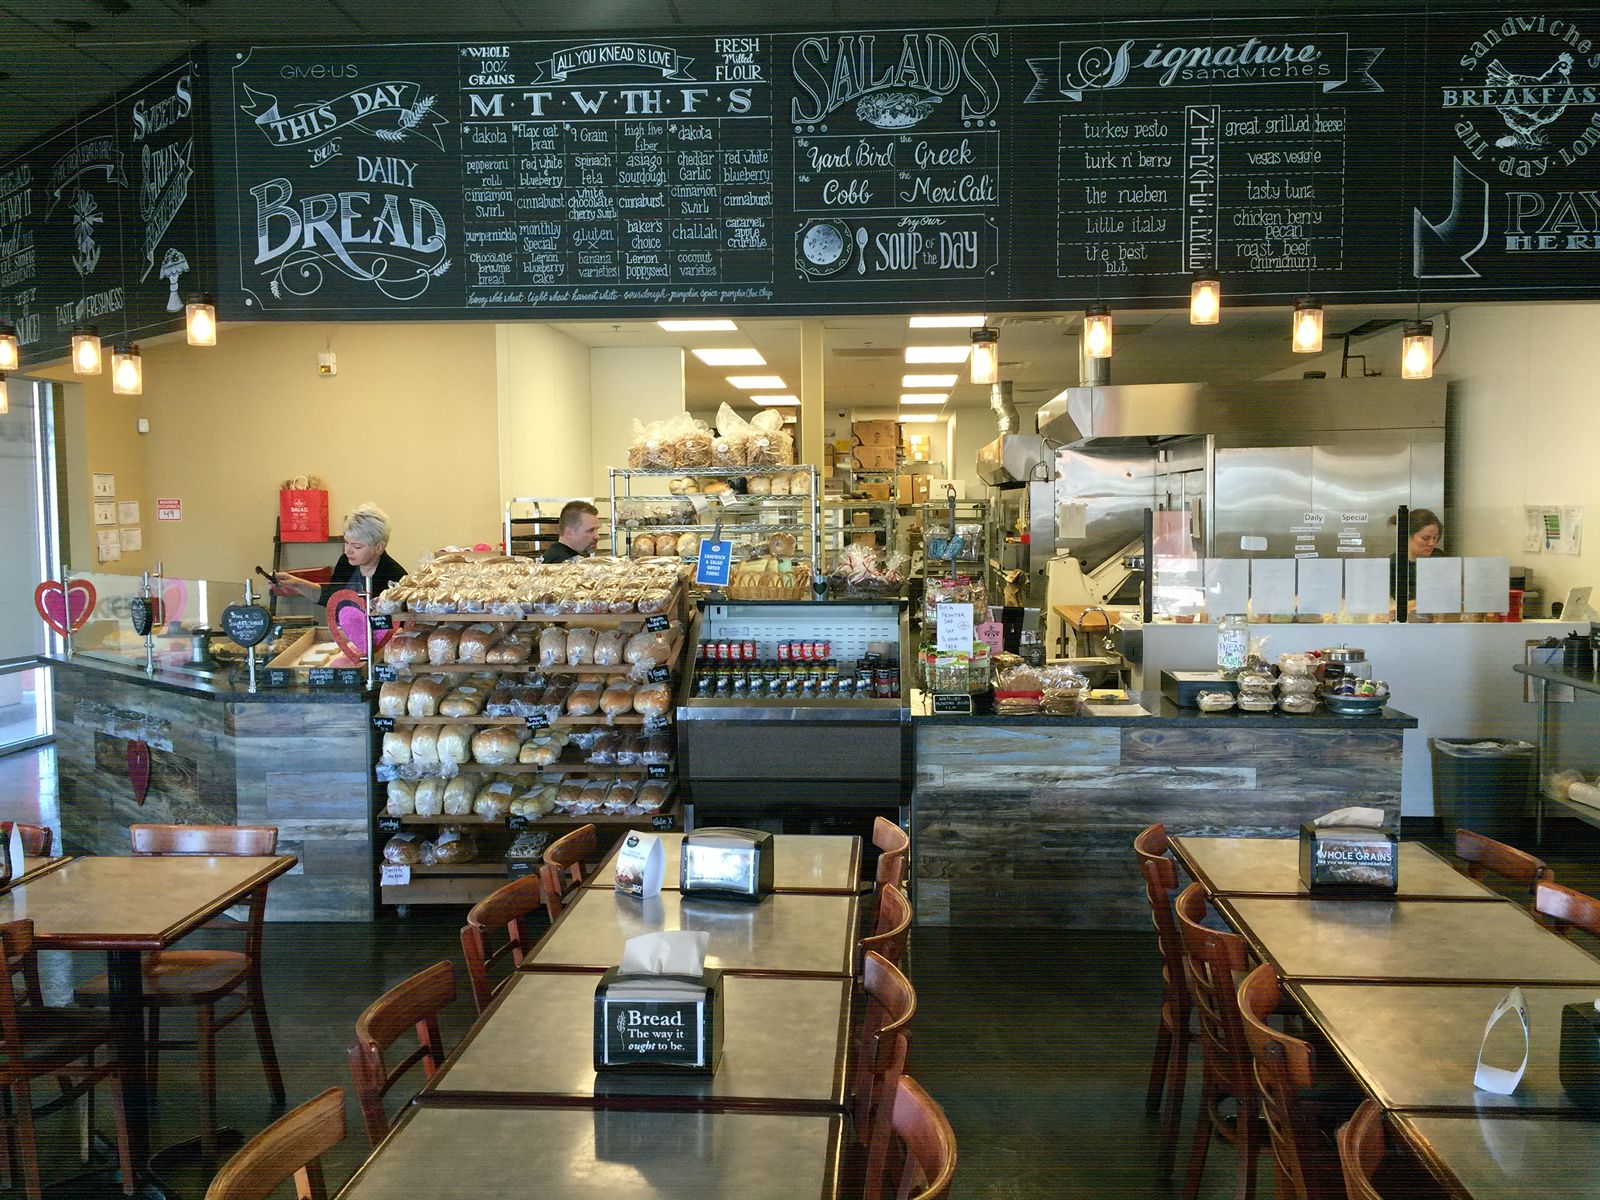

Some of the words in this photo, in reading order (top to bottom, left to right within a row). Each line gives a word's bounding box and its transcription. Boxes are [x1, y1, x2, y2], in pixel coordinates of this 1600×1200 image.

[467, 47, 510, 57] WHOLE
[715, 38, 760, 53] FRESH
[557, 53, 575, 72] ALL
[575, 49, 596, 65] YOU
[599, 46, 634, 62] KNEAD
[637, 48, 646, 63] IS
[649, 50, 671, 67] LOVE
[722, 53, 754, 64] Milled
[1066, 37, 1323, 90] Signature
[481, 60, 507, 74] 100%
[715, 65, 764, 81] FLOUR
[469, 75, 515, 85] GRAINS
[791, 32, 1000, 124] SALADS
[469, 94, 504, 117] M
[523, 92, 552, 116] T
[570, 91, 608, 114] W
[620, 90, 663, 114] TH
[680, 89, 709, 112] F
[727, 88, 753, 113] S
[271, 106, 336, 142] THIS
[351, 85, 408, 115] DAY
[517, 124, 540, 138] flax
[542, 124, 559, 138] oat
[624, 122, 645, 141] high
[647, 122, 664, 136] five
[678, 125, 713, 141] dakota
[1084, 121, 1129, 140] turkey
[1135, 119, 1168, 138] pesto
[1225, 117, 1261, 137] great
[1265, 114, 1311, 133] grilled
[472, 126, 507, 143] dakota
[580, 127, 608, 142] Grain
[530, 138, 556, 151] bran
[678, 151, 714, 166] cheddar
[724, 152, 741, 165] red
[743, 150, 768, 165] white
[807, 146, 852, 173] Yard
[856, 140, 895, 168] Bird
[914, 138, 976, 170] Greek
[1085, 151, 1117, 169] turk
[1138, 151, 1172, 168] berry
[1247, 151, 1282, 165] vegas
[466, 159, 509, 175] pepperoni
[520, 156, 538, 170] red
[540, 155, 563, 169] white
[575, 155, 612, 169] spinach
[626, 154, 662, 171] asiago
[1499, 155, 1549, 178] day
[357, 156, 418, 187] DAILY
[582, 169, 603, 185] feta
[723, 167, 770, 184] blueberry
[520, 173, 563, 188] blueberry
[464, 189, 513, 202] cinnamon
[576, 188, 604, 199] white
[671, 186, 717, 197] cinnamon
[823, 179, 874, 205] Cobb
[1086, 186, 1107, 204] the
[1246, 180, 1280, 200] tasty
[517, 193, 566, 209] cinnaburst
[567, 196, 614, 208] chocolate
[619, 193, 665, 208] cinnaburst
[723, 192, 772, 207] cinnaburst
[568, 209, 596, 221] cherry
[1233, 209, 1283, 226] chicken
[250, 178, 446, 280] BREAD
[519, 222, 561, 239] monthly
[627, 220, 663, 233] baker's
[672, 223, 718, 240] challah
[573, 227, 614, 247] gluten
[632, 235, 662, 250] choice
[876, 232, 923, 271] SOUP
[1118, 245, 1148, 260] best
[1236, 241, 1274, 257] roast
[1283, 239, 1311, 256] beef
[578, 253, 612, 264] banana
[677, 252, 712, 263] coconut
[523, 262, 564, 276] blueberry
[478, 273, 505, 285] bread
[1305, 513, 1323, 522] Daily
[1342, 513, 1367, 521] Special
[1317, 851, 1353, 860] WHOLE
[1355, 851, 1392, 862] GRAINS
[627, 1010, 685, 1026] Bread.
[627, 1028, 650, 1039] The
[652, 1031, 673, 1042] way
[676, 1028, 684, 1039] it
[628, 1040, 656, 1053] ought
[658, 1043, 668, 1051] to
[670, 1041, 685, 1051] be.
